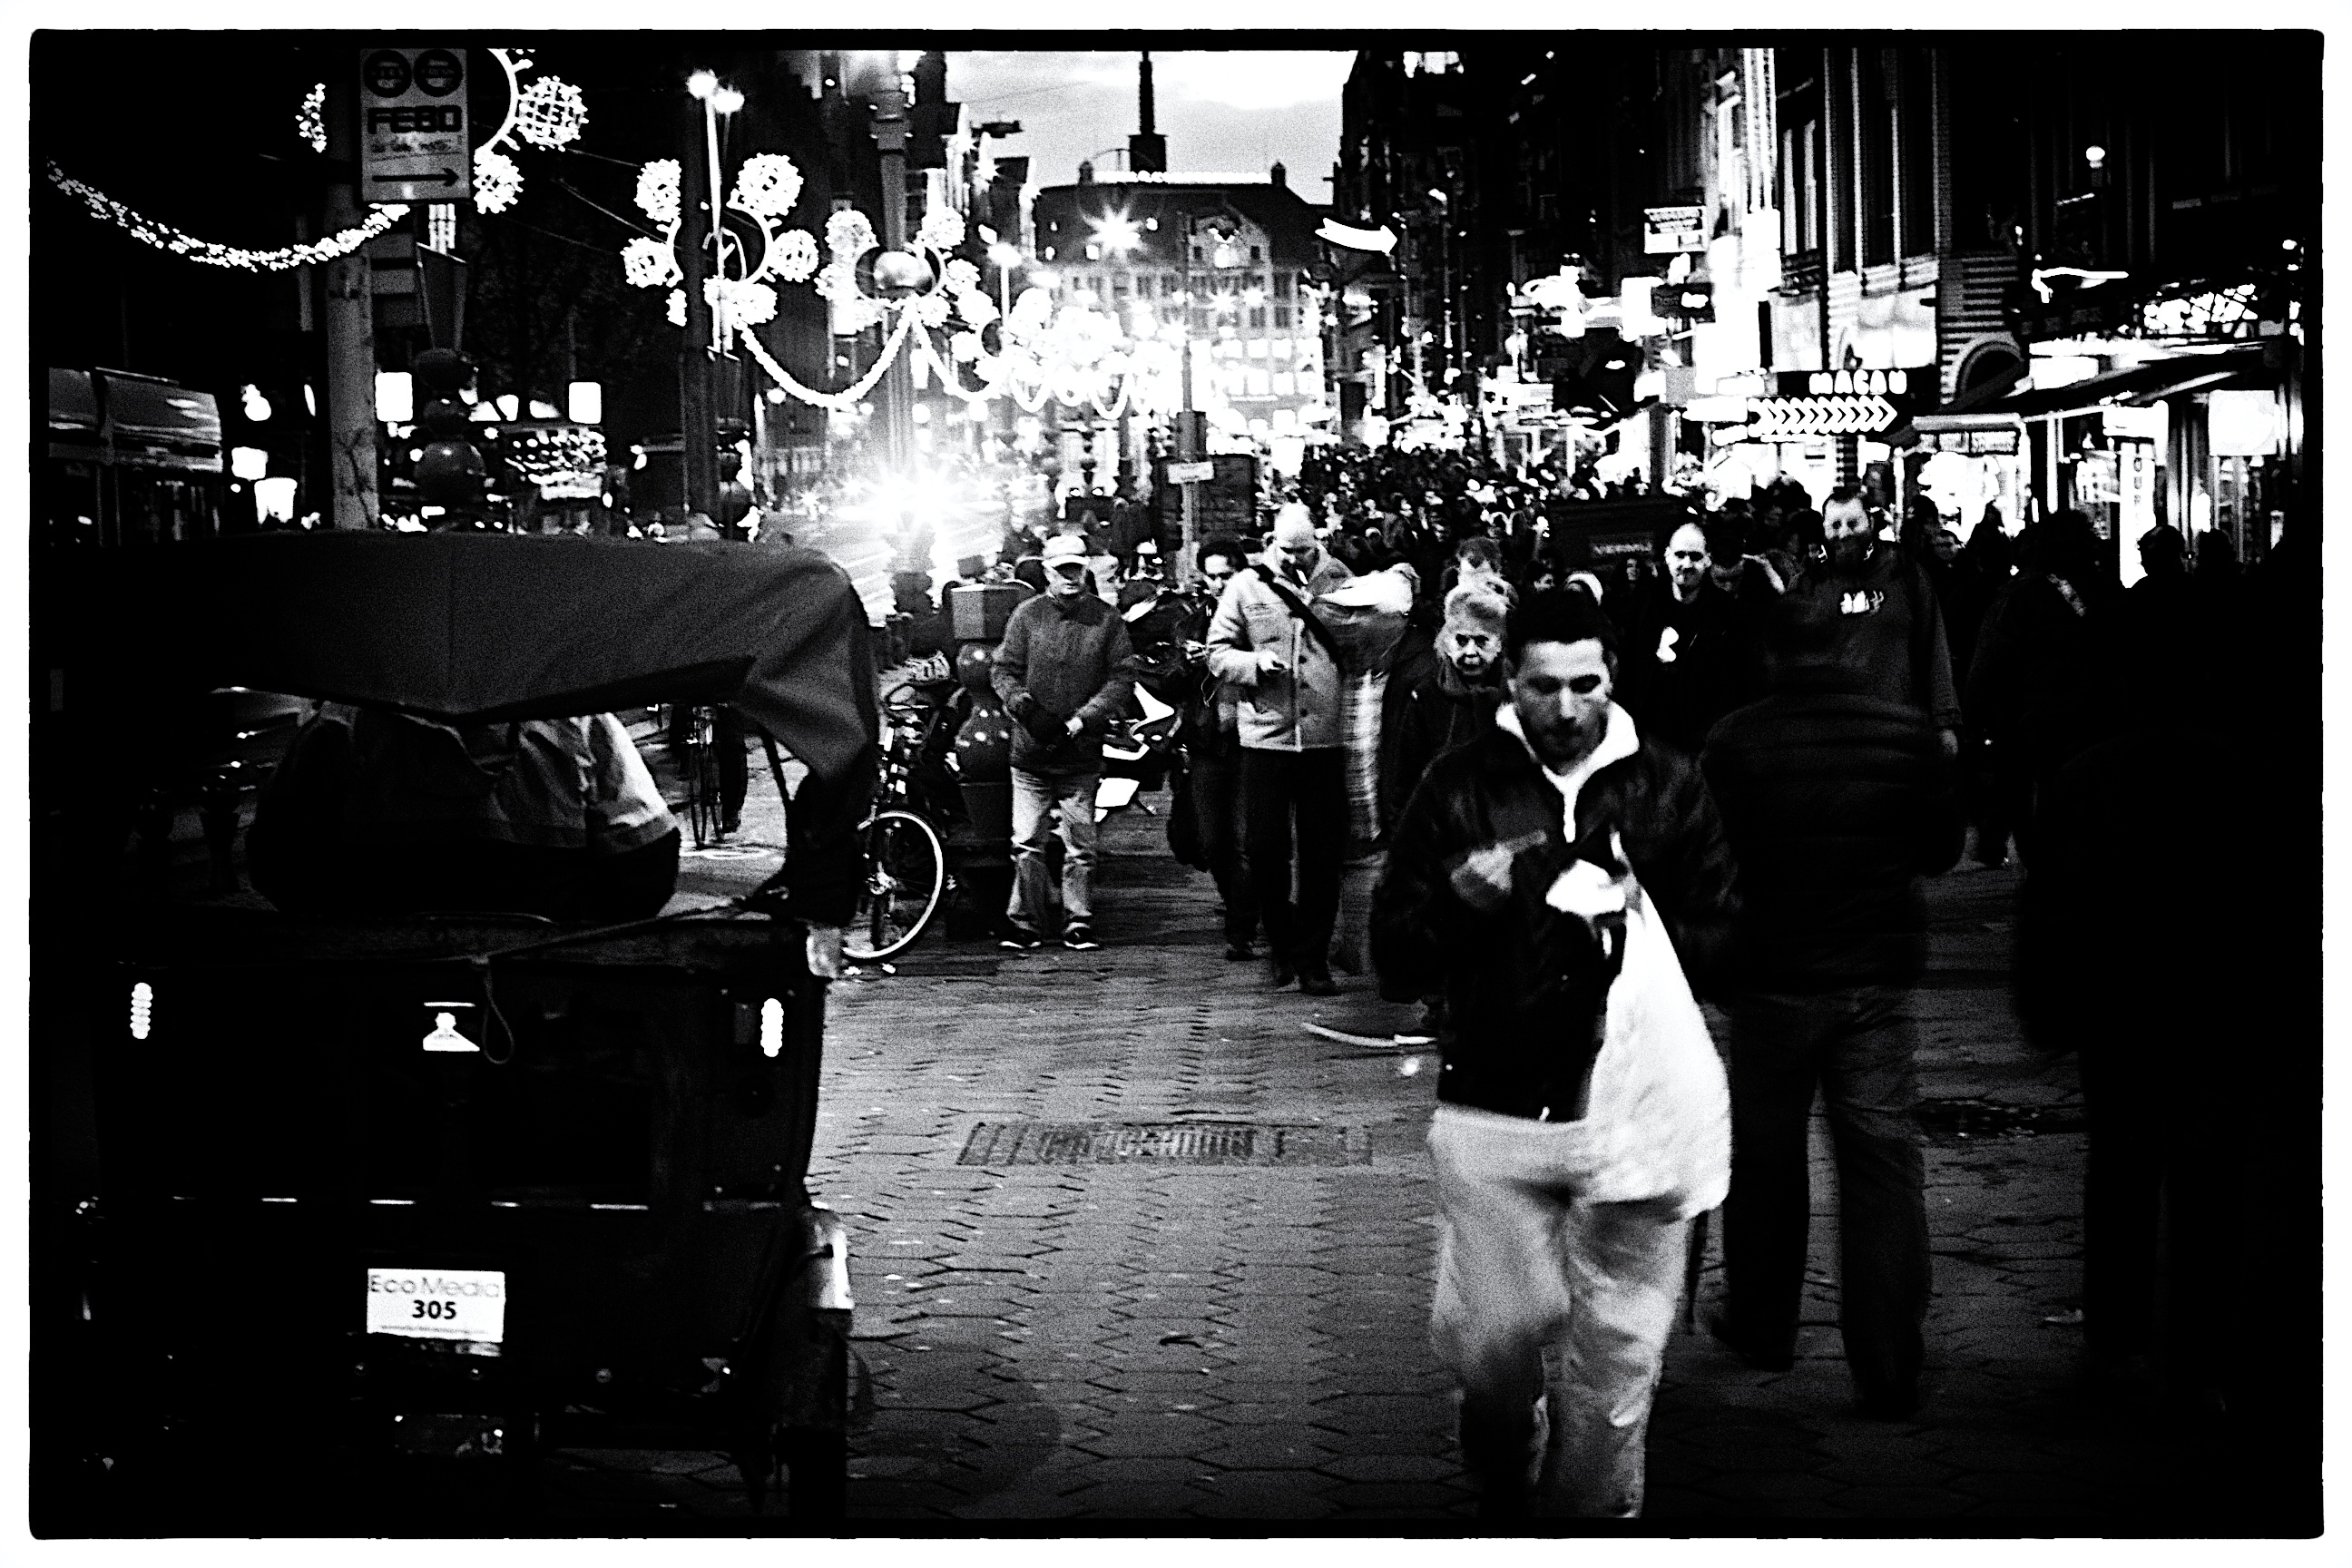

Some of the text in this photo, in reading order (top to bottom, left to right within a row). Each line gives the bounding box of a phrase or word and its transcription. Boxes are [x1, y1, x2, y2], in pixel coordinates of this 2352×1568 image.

[368, 104, 463, 134] FEBO
[1808, 368, 1907, 396] MACAU
[412, 1299, 456, 1320] 305
